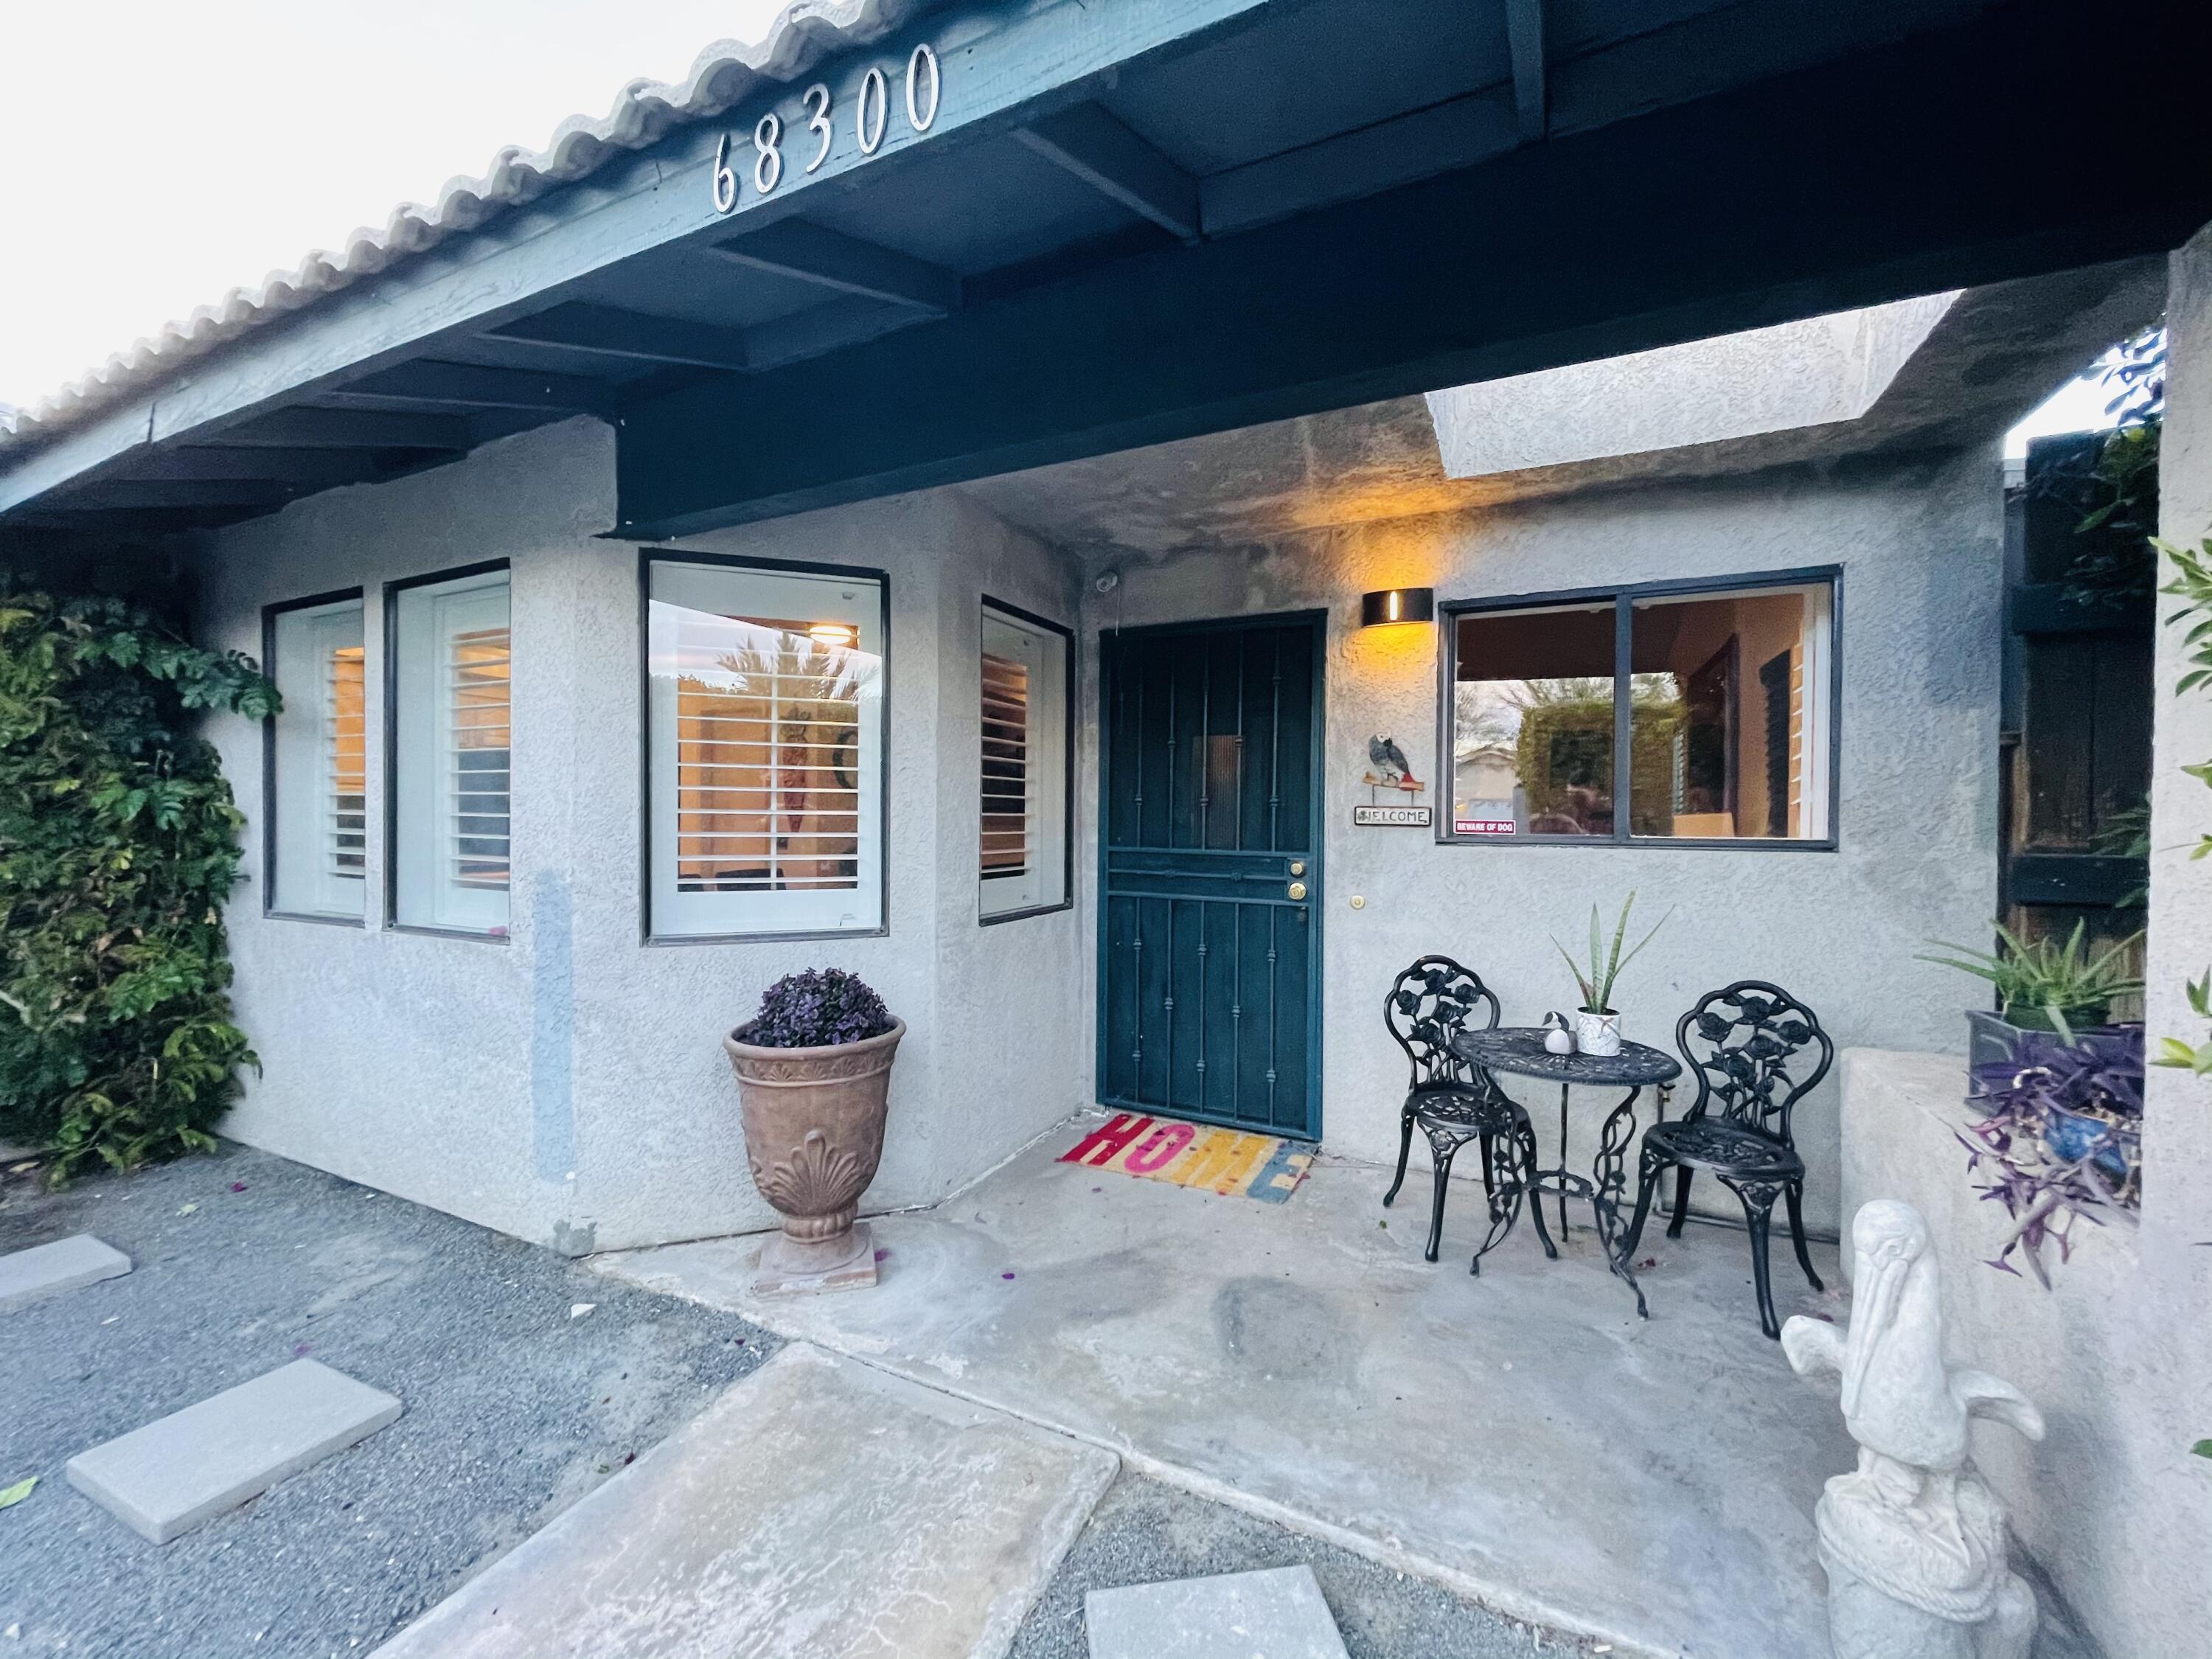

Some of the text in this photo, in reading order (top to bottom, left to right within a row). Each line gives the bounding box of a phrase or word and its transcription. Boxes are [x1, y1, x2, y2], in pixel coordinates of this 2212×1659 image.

[713, 44, 939, 214] 68300
[1457, 822, 1513, 832] BEWARE OF DOG
[1061, 1113, 1317, 1205] HOME
